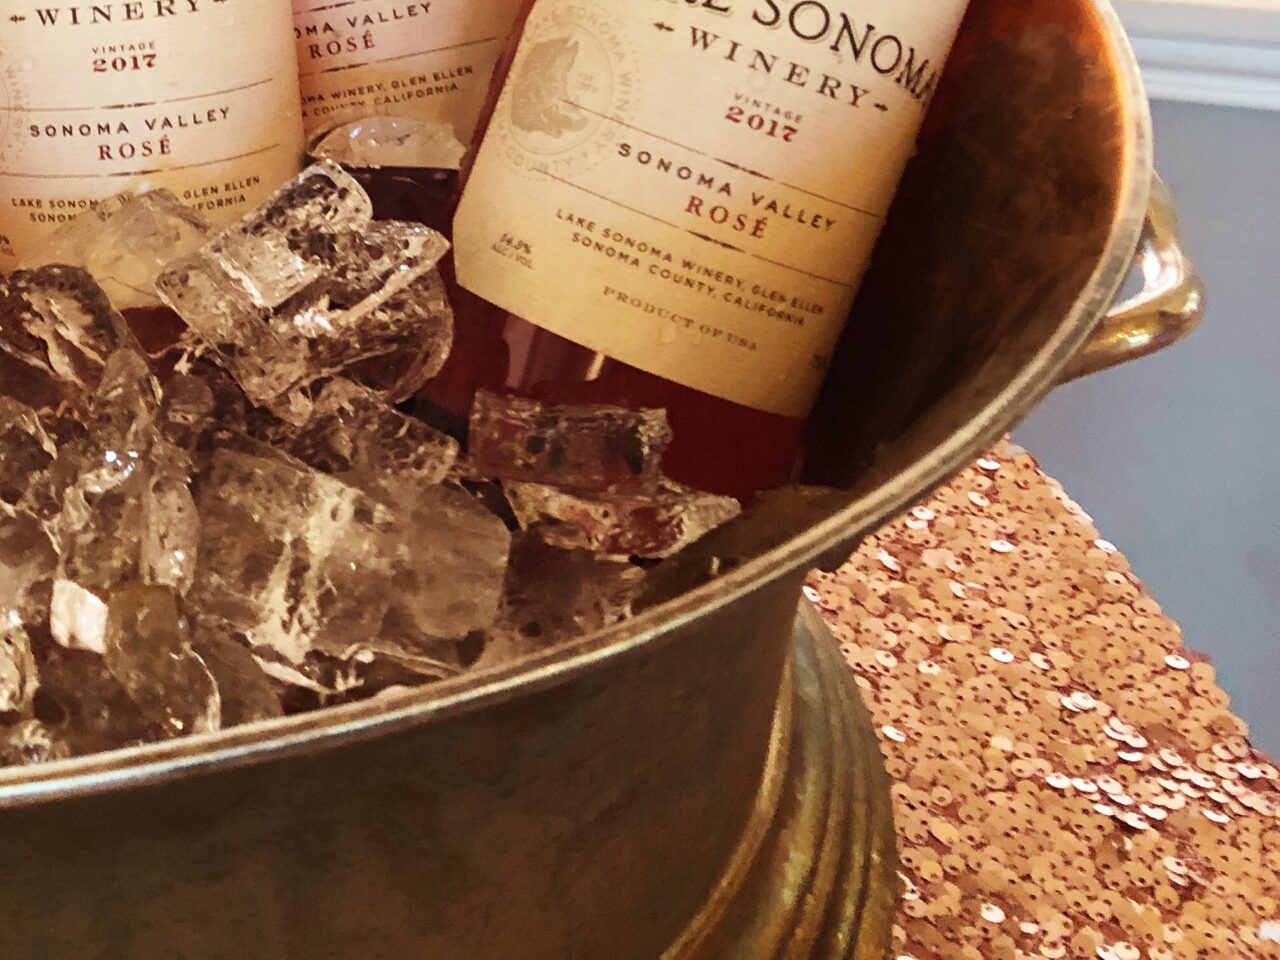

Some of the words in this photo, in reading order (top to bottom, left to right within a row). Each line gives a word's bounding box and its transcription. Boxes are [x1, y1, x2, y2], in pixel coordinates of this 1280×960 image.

[294, 22, 334, 39] OMA
[347, 2, 431, 28] VALLEY
[92, 41, 156, 54] VINTAGE
[309, 30, 375, 59] ROSÉ
[92, 54, 157, 72] 2017
[690, 26, 869, 108] WINERY
[30, 122, 130, 138] SONOMA
[145, 107, 230, 132] VALLEY
[724, 106, 798, 142] 2017
[735, 93, 803, 124] VINTAGE
[98, 135, 172, 160] ROSÉ
[11, 197, 43, 209] LAKE
[49, 196, 99, 210] SONOM
[182, 184, 218, 201] GLEN
[224, 176, 261, 194] ELLEN
[191, 193, 247, 212] IFORNIA
[618, 143, 732, 196] SONOMA
[752, 192, 837, 232] VALLEY
[685, 195, 768, 238] ROSÉ
[556, 208, 595, 233] LAKE
[602, 226, 673, 263] SONOMA
[571, 232, 641, 268] SONOMA
[603, 286, 694, 329] PRODUCT
